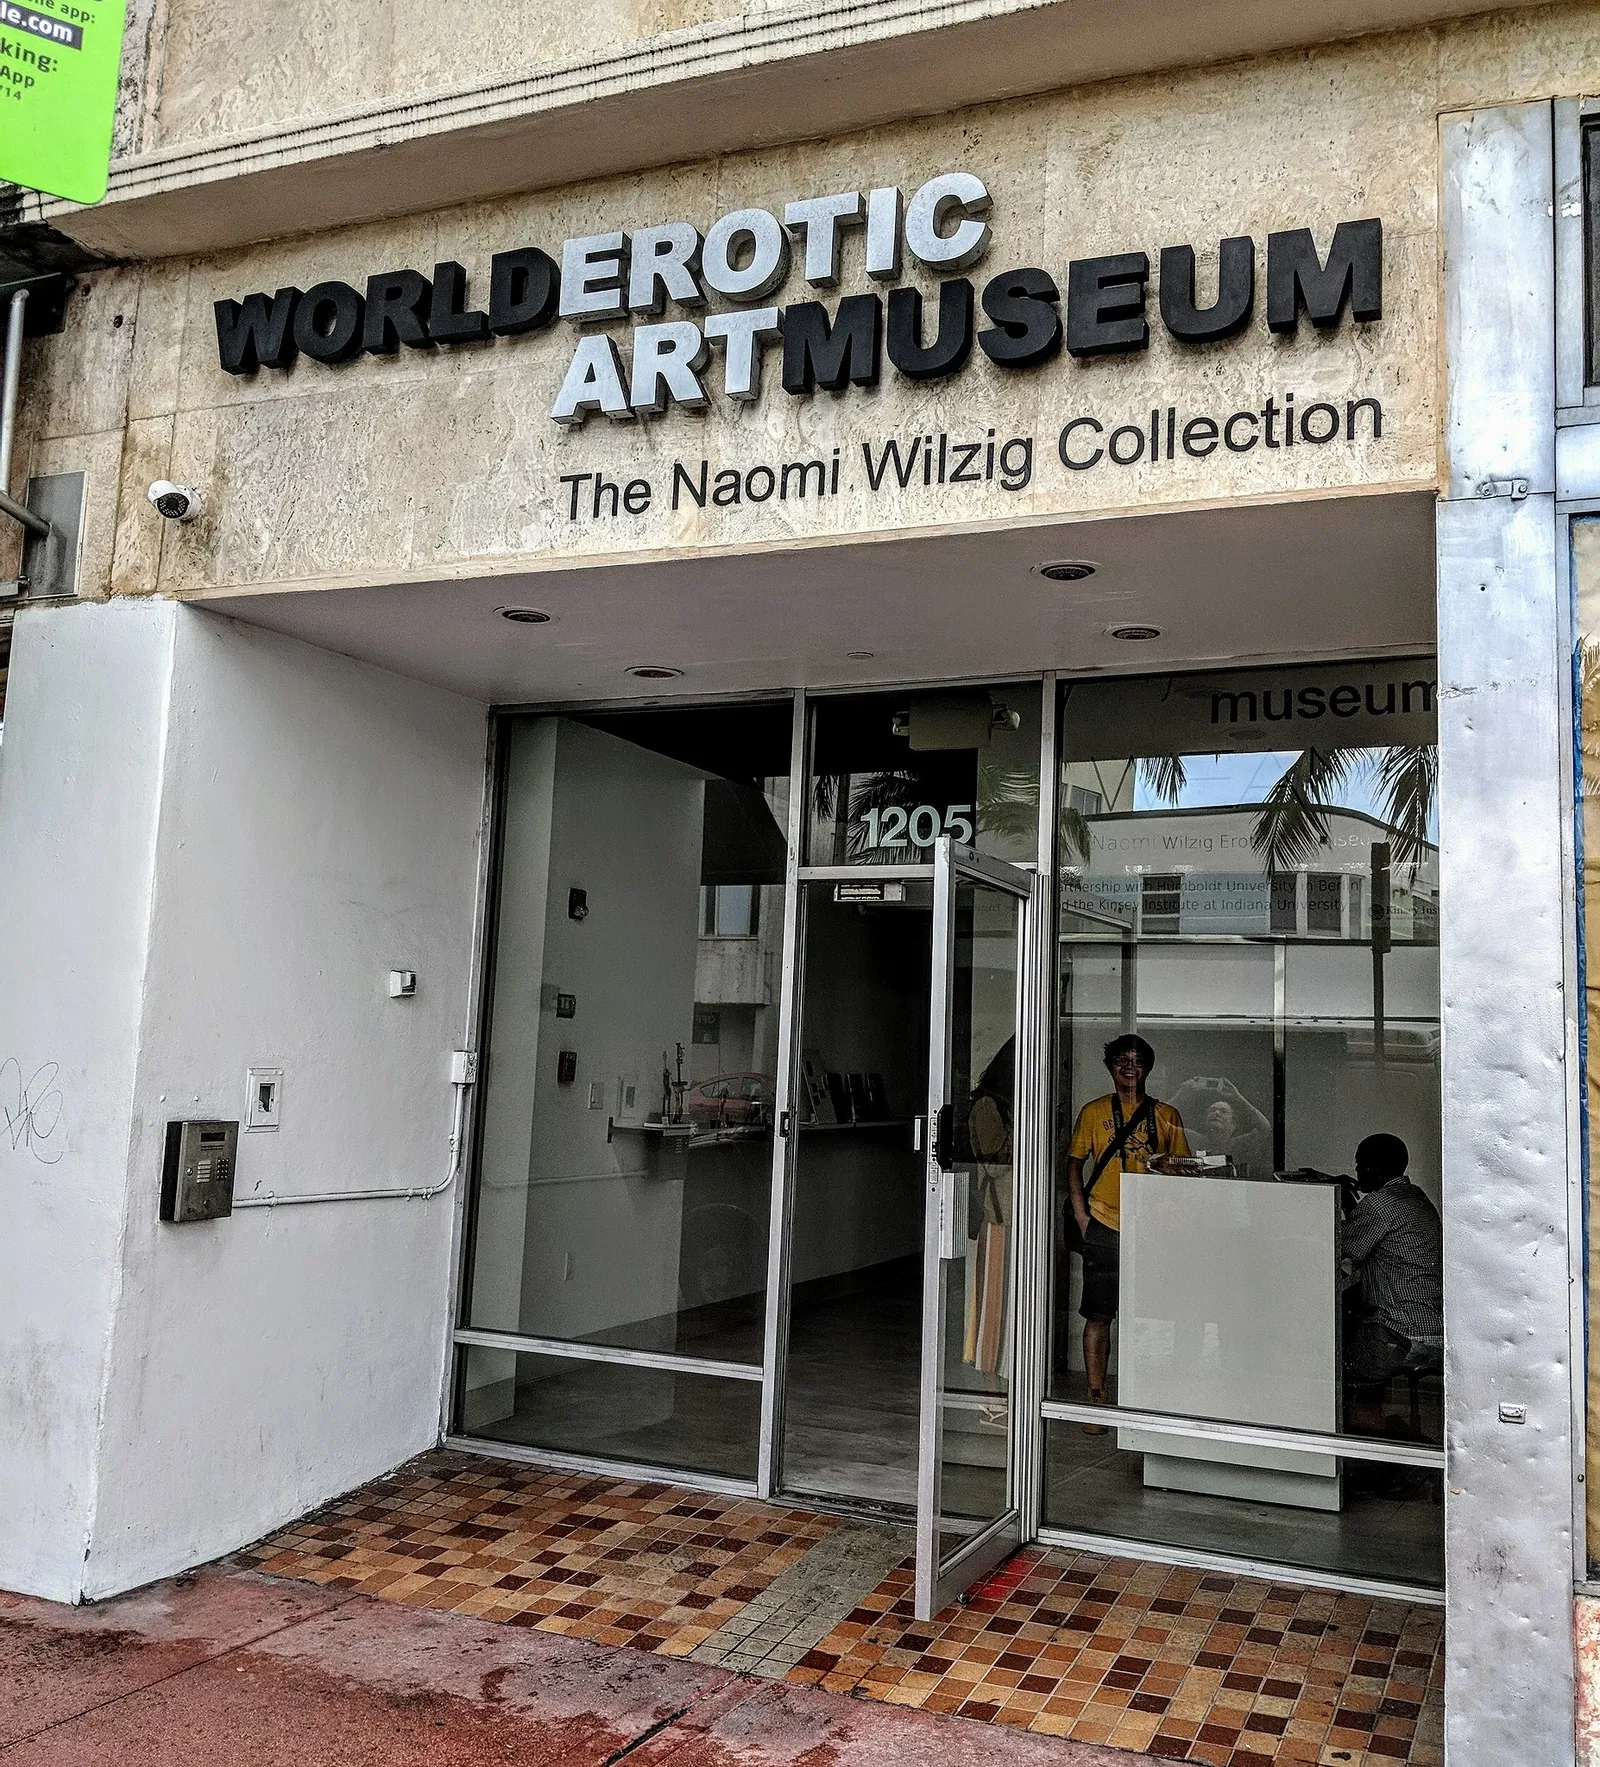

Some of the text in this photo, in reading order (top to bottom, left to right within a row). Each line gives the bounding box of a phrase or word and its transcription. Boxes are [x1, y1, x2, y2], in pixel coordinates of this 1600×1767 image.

[0, 2, 72, 43] le.com
[60, 4, 95, 23] app:
[0, 37, 58, 73] king:
[0, 65, 35, 89] App
[0, 85, 21, 101] 14
[560, 392, 1382, 520] The Naomi Wilzig Collection
[861, 804, 973, 848] 1205
[1092, 834, 1155, 851] Naomi
[1162, 834, 1214, 853] Wilzig
[1157, 880, 1223, 892] Humboldt
[1226, 879, 1296, 894] University
[1073, 899, 1094, 911] the
[1099, 898, 1139, 913] Kinsey
[1144, 898, 1200, 911] Institute
[1203, 899, 1217, 911] at
[1220, 898, 1270, 911] Indiana
[1277, 898, 1348, 913] University
